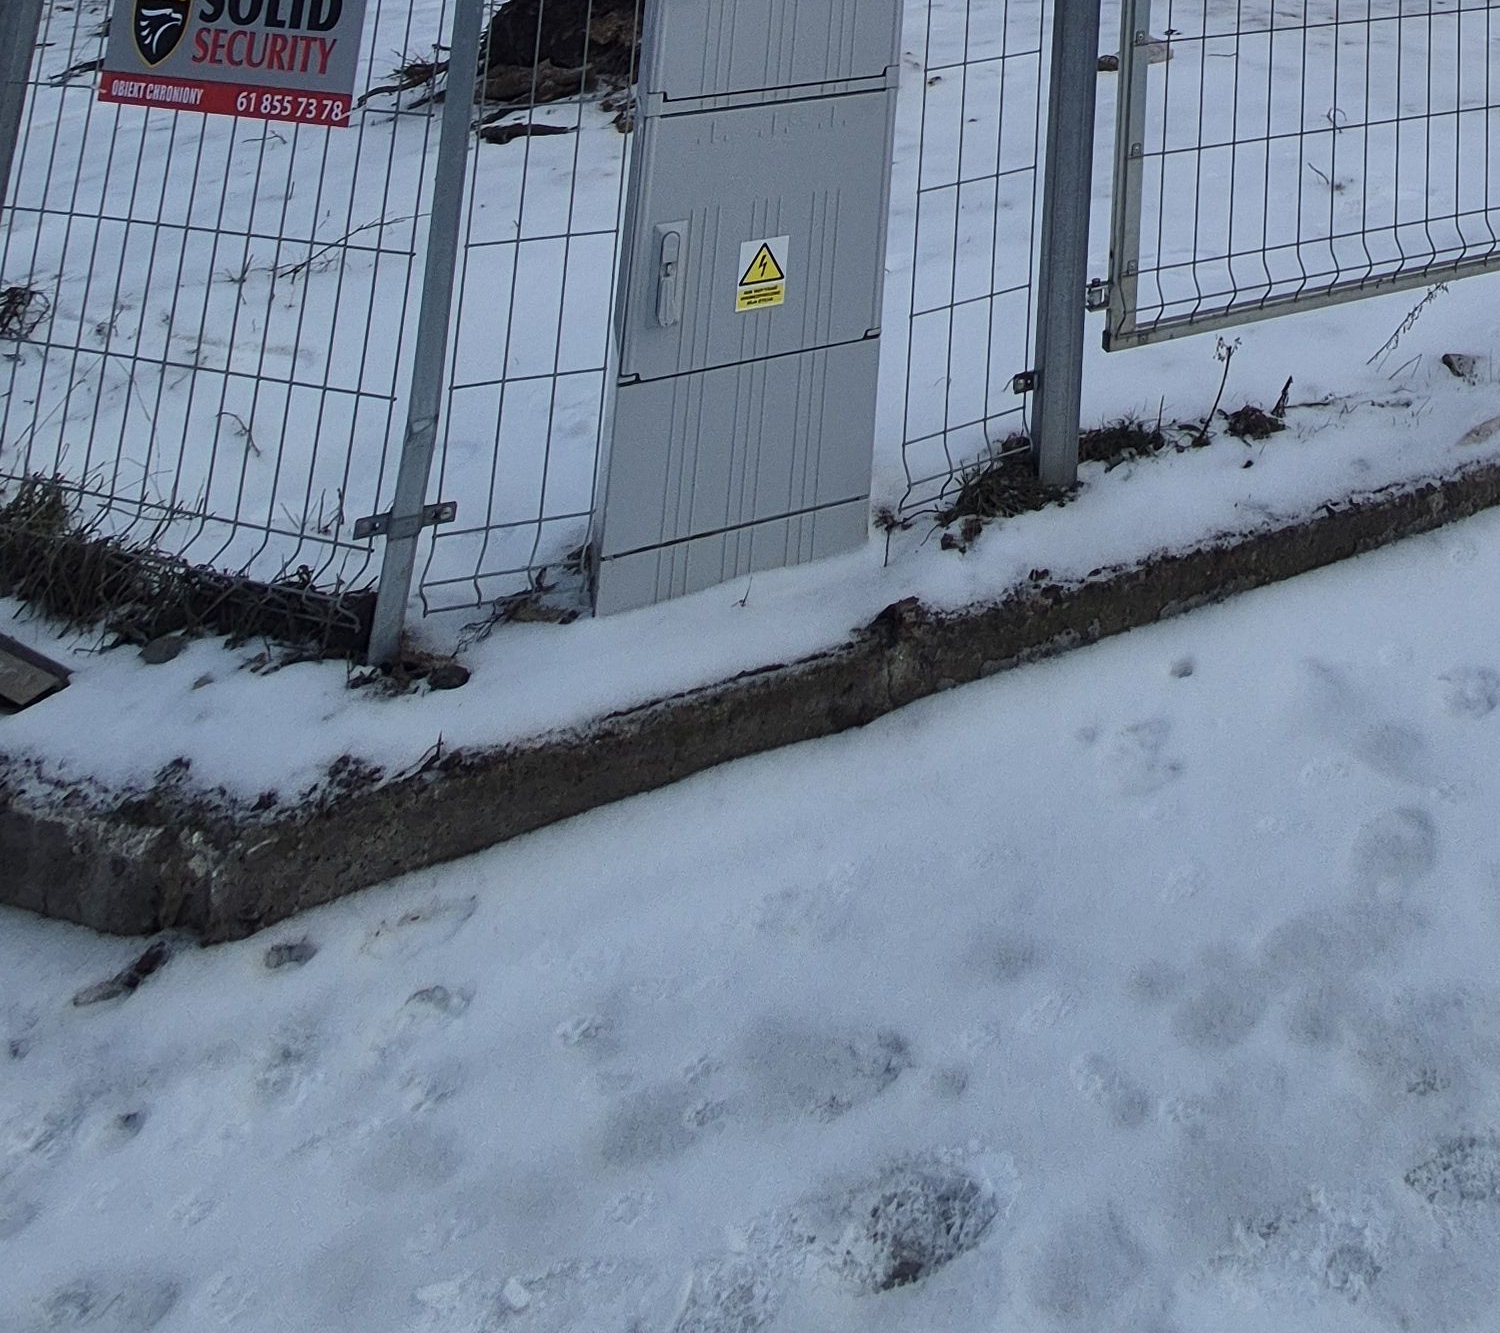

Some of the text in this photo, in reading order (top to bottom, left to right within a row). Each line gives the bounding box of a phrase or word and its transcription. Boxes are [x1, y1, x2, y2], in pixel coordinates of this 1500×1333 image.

[191, 27, 337, 75] SECURITY
[146, 83, 204, 105] CHRONIONY
[236, 91, 343, 121] 61 855 73 78
